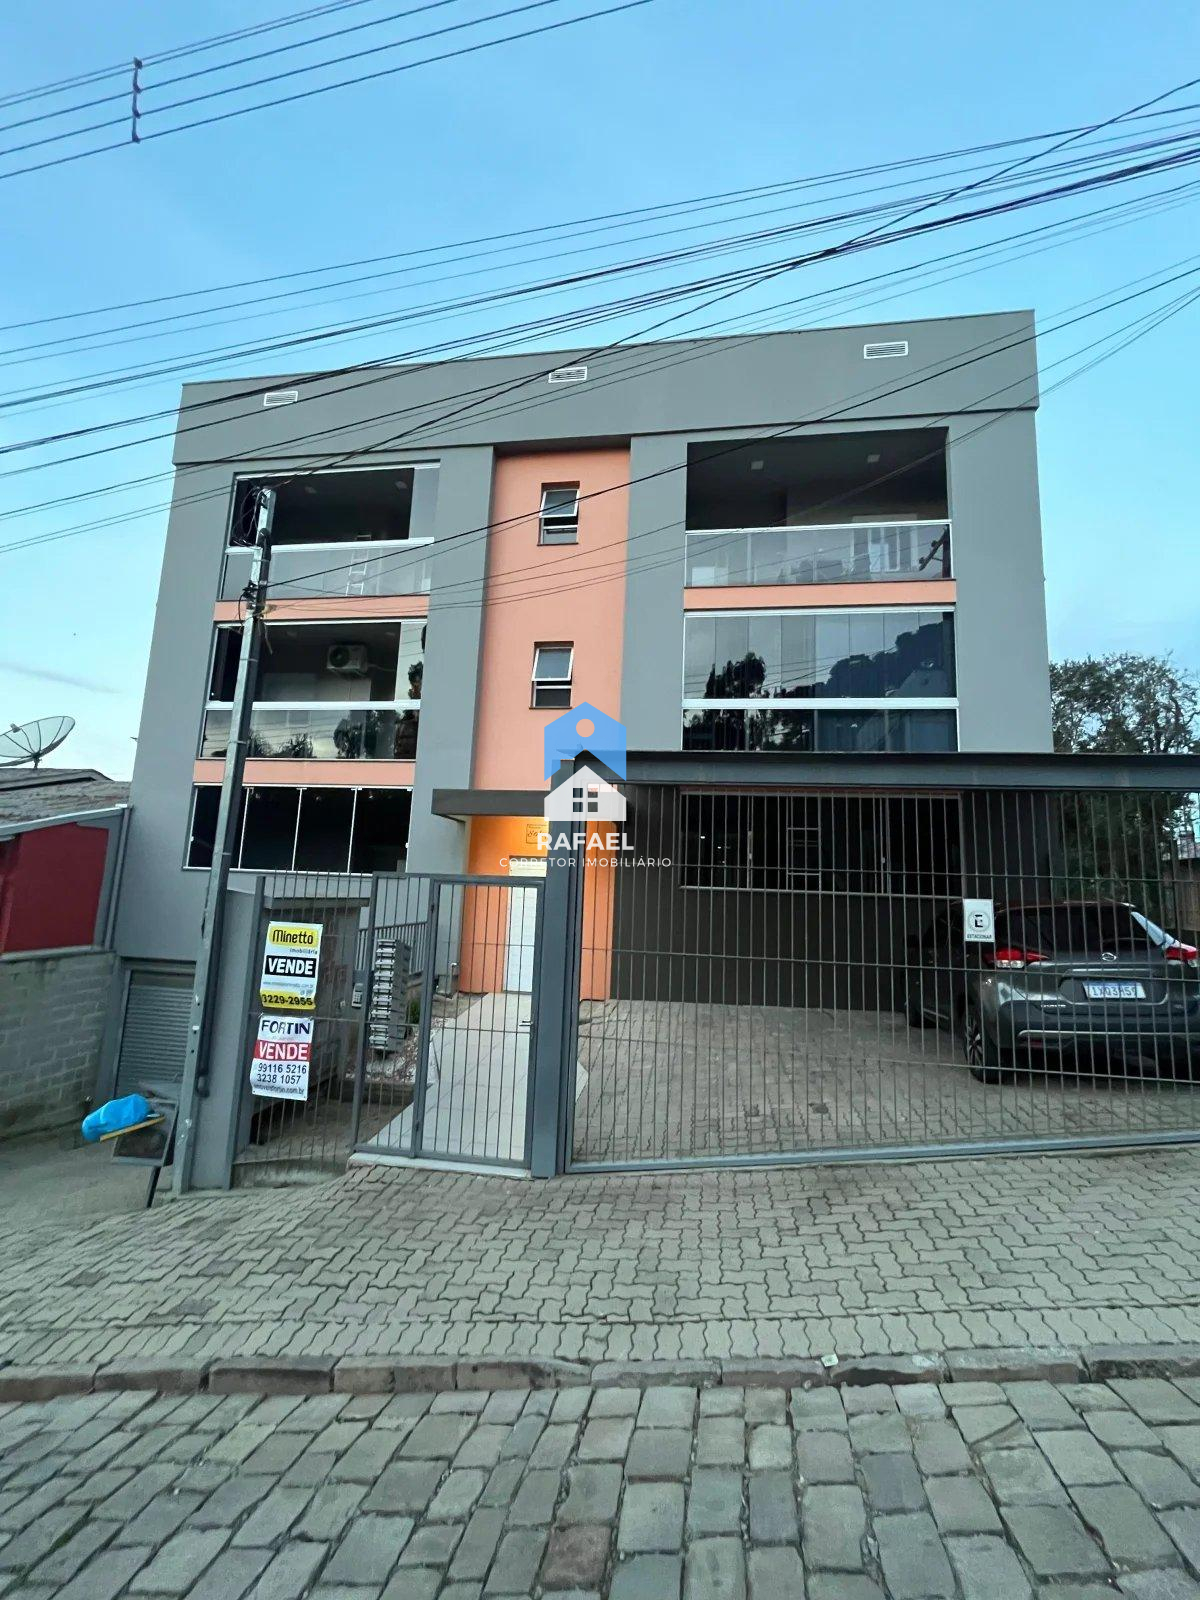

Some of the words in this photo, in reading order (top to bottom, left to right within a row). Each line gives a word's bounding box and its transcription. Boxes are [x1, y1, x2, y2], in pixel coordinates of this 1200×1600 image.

[272, 929, 314, 945] Minetto
[268, 957, 314, 975] VENDE
[262, 993, 314, 1006] 3229-2955
[261, 1019, 311, 1035] FORTIN
[259, 1041, 309, 1061] VENDE
[258, 1062, 283, 1073] 99116
[286, 1064, 307, 1074] 5216
[257, 1073, 277, 1084] 3238
[280, 1074, 302, 1085] 1057
